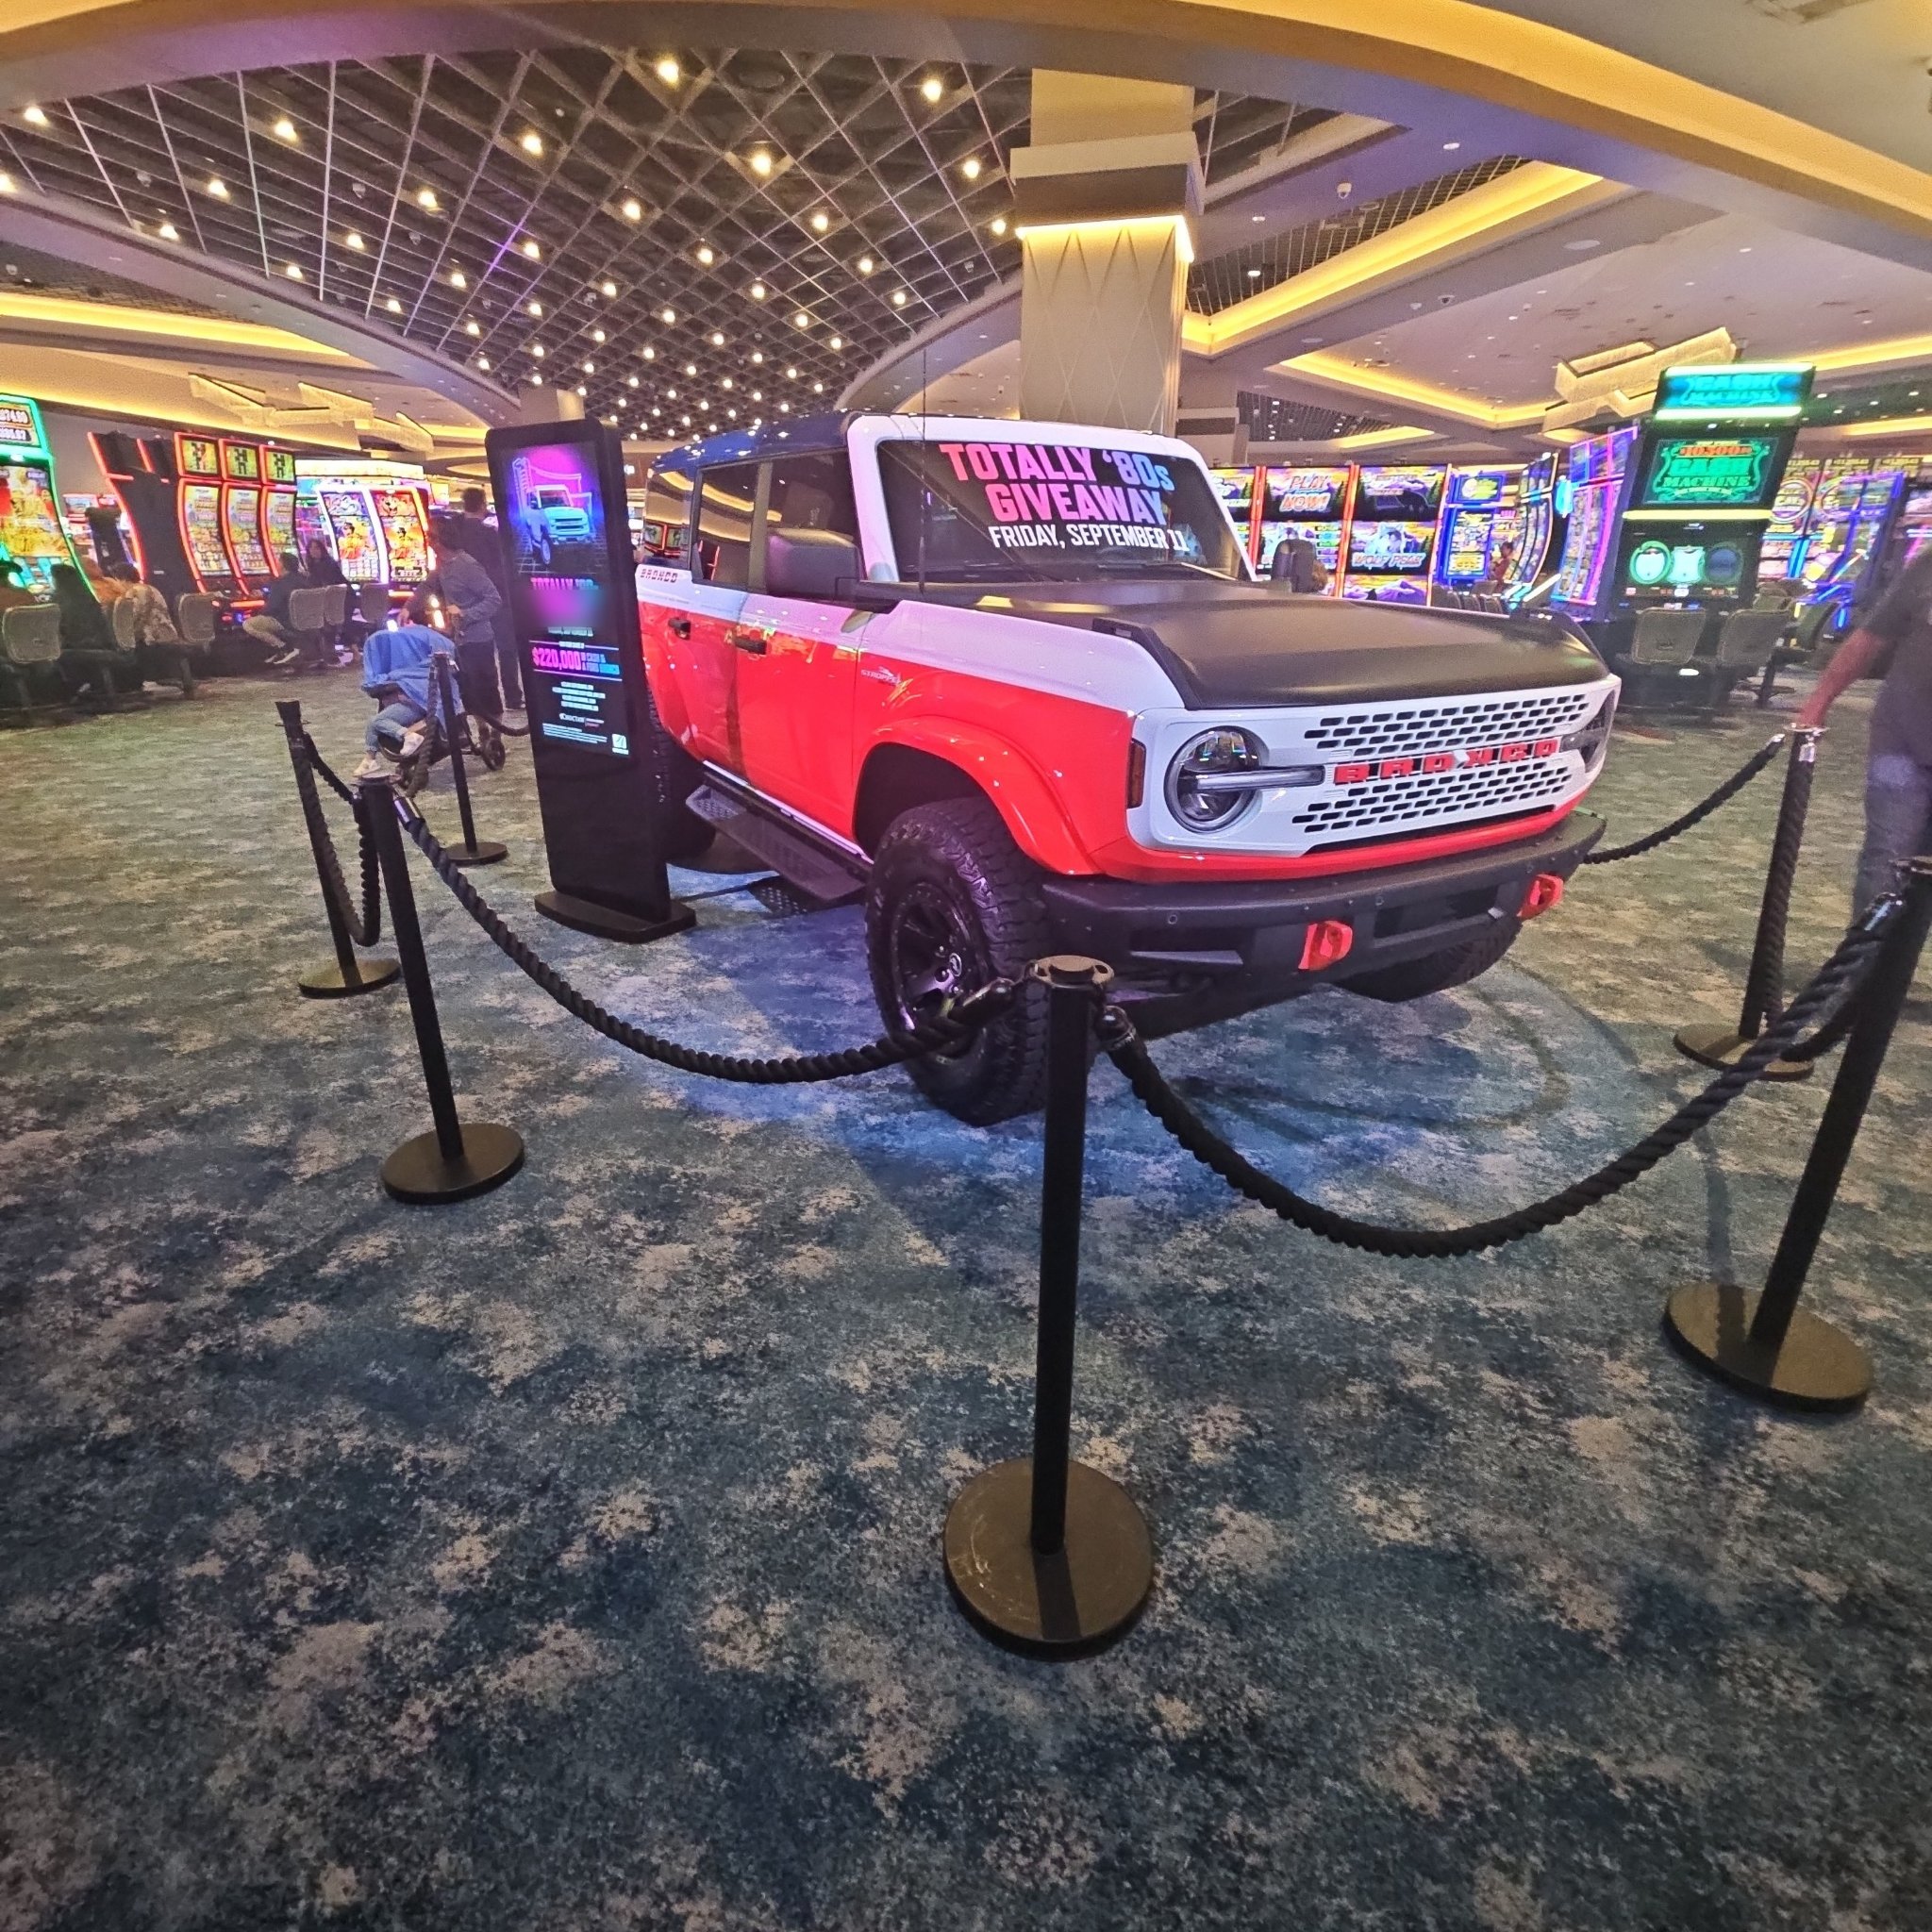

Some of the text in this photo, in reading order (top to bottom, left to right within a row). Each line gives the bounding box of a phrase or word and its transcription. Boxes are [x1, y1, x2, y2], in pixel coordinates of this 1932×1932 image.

[939, 443, 1175, 491] TOTALLY '80s
[1663, 476, 1751, 487] MACHINE
[985, 483, 1167, 525] GIVEAWAY
[989, 524, 1190, 551] FRIDAY, SEPTEMBER 11
[531, 647, 582, 671] $220,000
